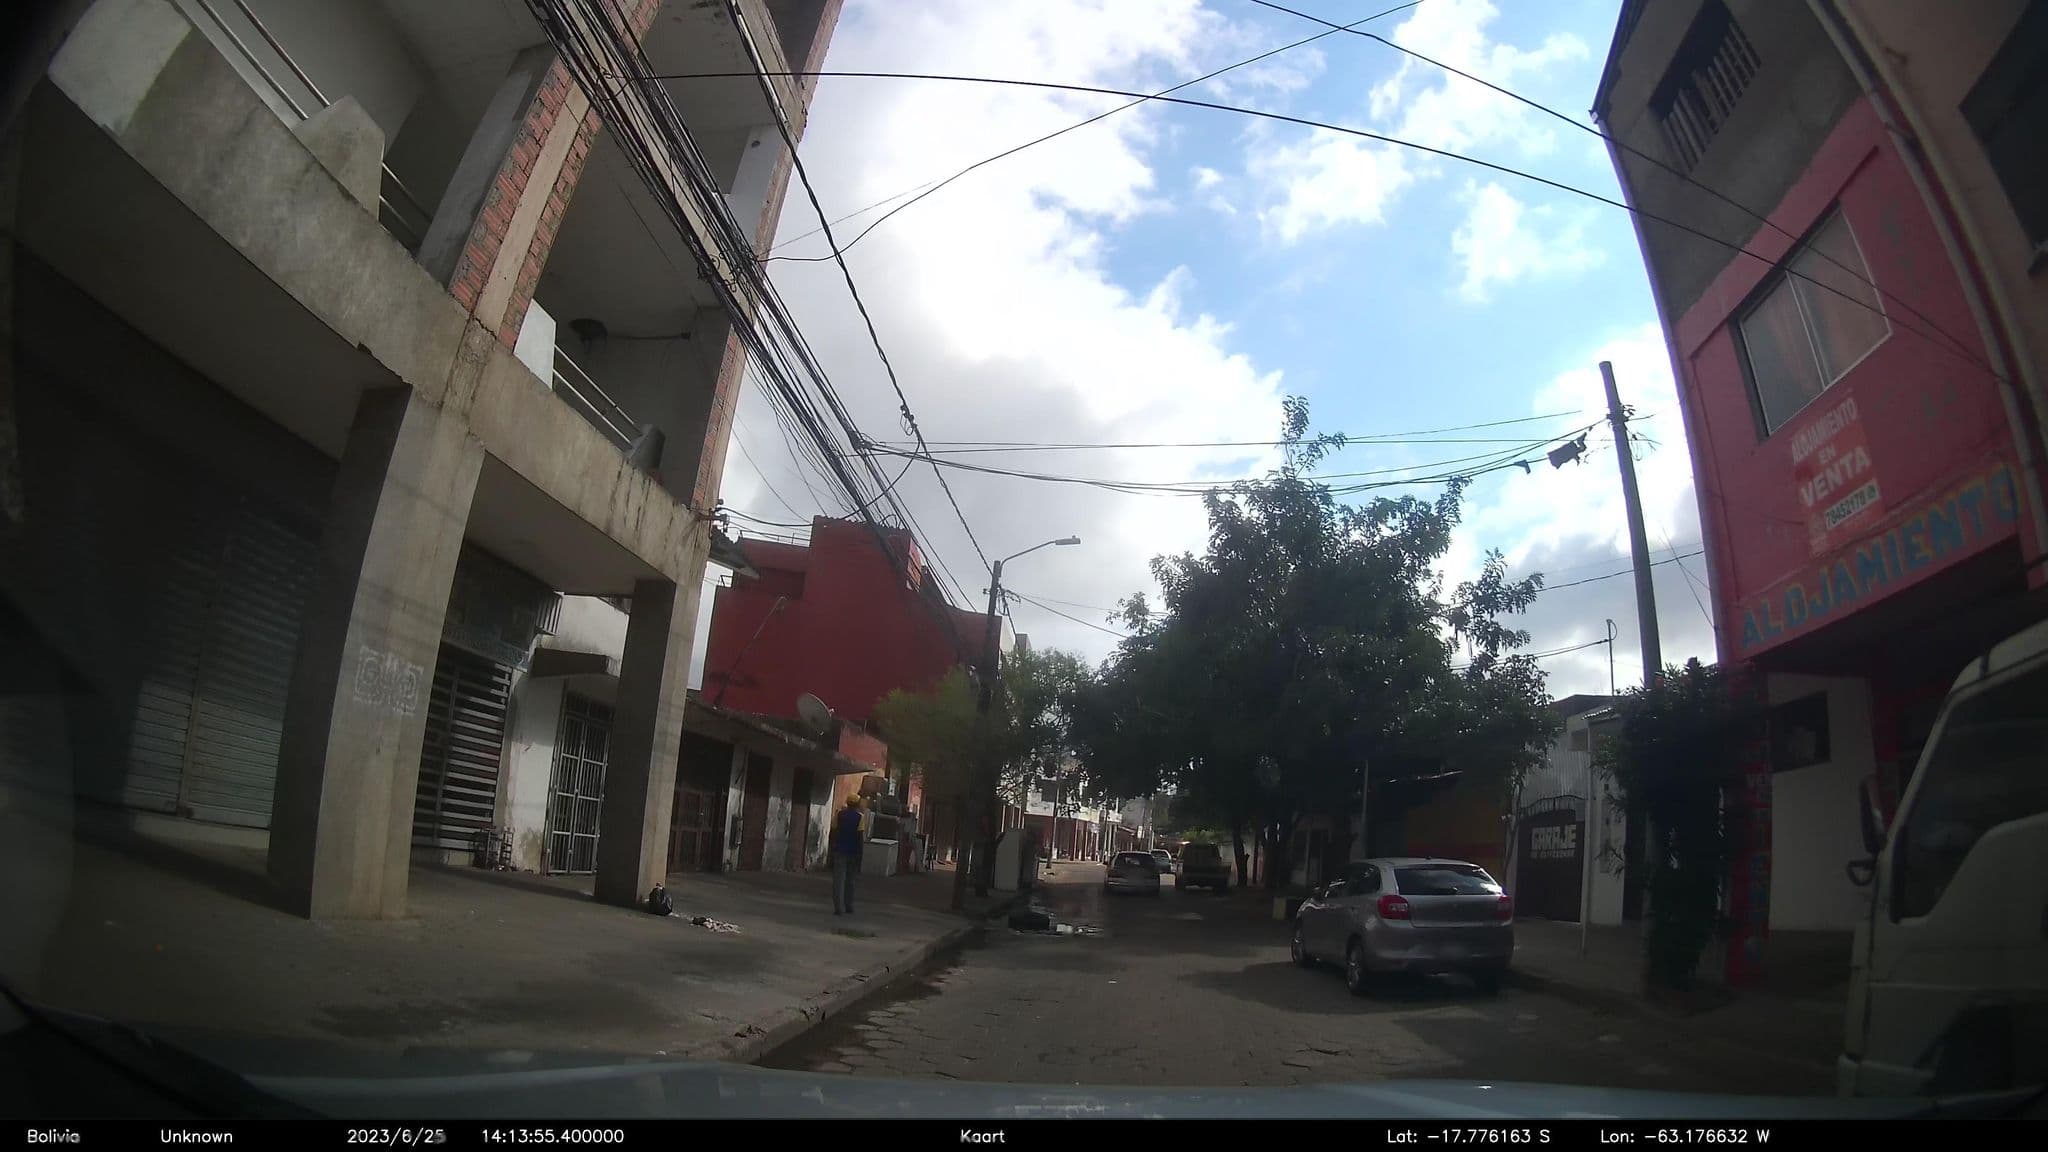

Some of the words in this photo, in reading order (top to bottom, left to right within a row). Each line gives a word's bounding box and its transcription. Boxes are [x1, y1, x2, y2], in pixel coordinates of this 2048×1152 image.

[1800, 446, 1872, 507] VENTA
[1818, 446, 1837, 464] EN
[1742, 462, 2022, 648] ALOJAMIENTO
